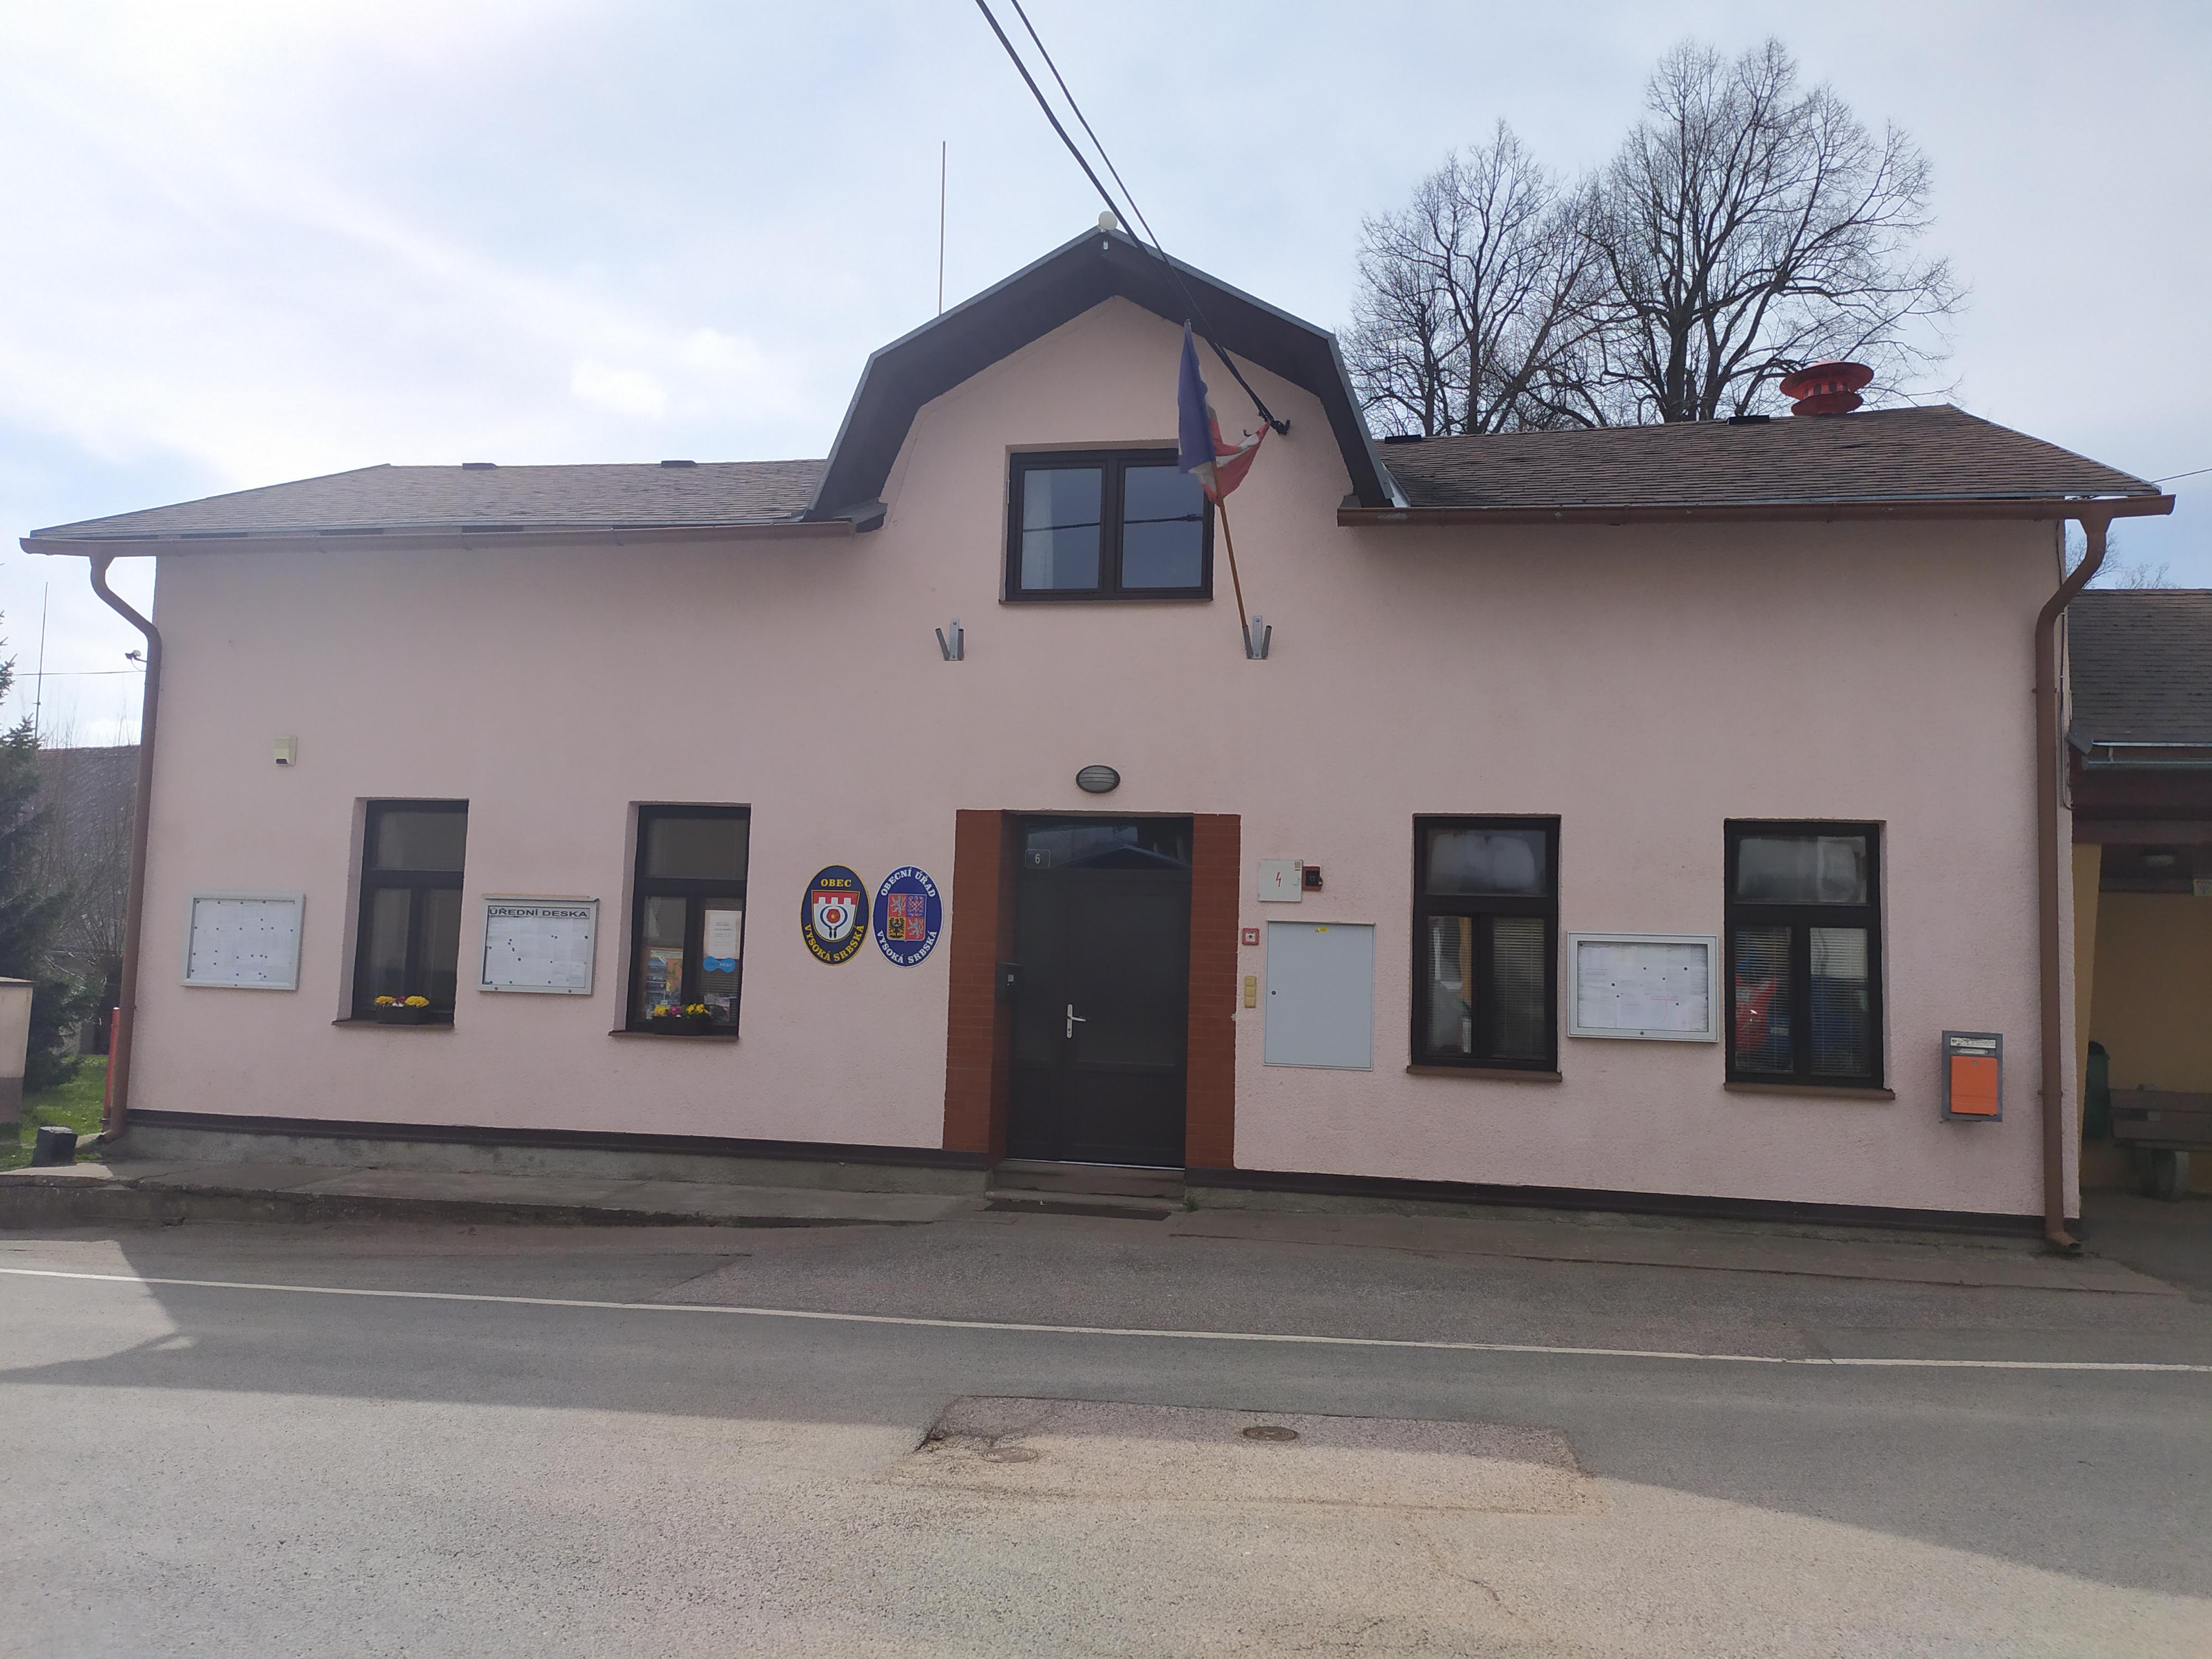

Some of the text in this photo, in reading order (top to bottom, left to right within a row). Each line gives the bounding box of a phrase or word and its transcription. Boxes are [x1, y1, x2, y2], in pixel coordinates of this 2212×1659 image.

[1035, 853, 1040, 864] 6
[821, 879, 852, 887] OBEC
[880, 868, 936, 898] OBECNÍ ÚŘAD
[489, 907, 538, 916] ÚŘEDNÍ
[805, 924, 864, 961] VYSOKÁ SRBSKÁ
[877, 930, 937, 964] VYSOKÁ SRBSKÁ
